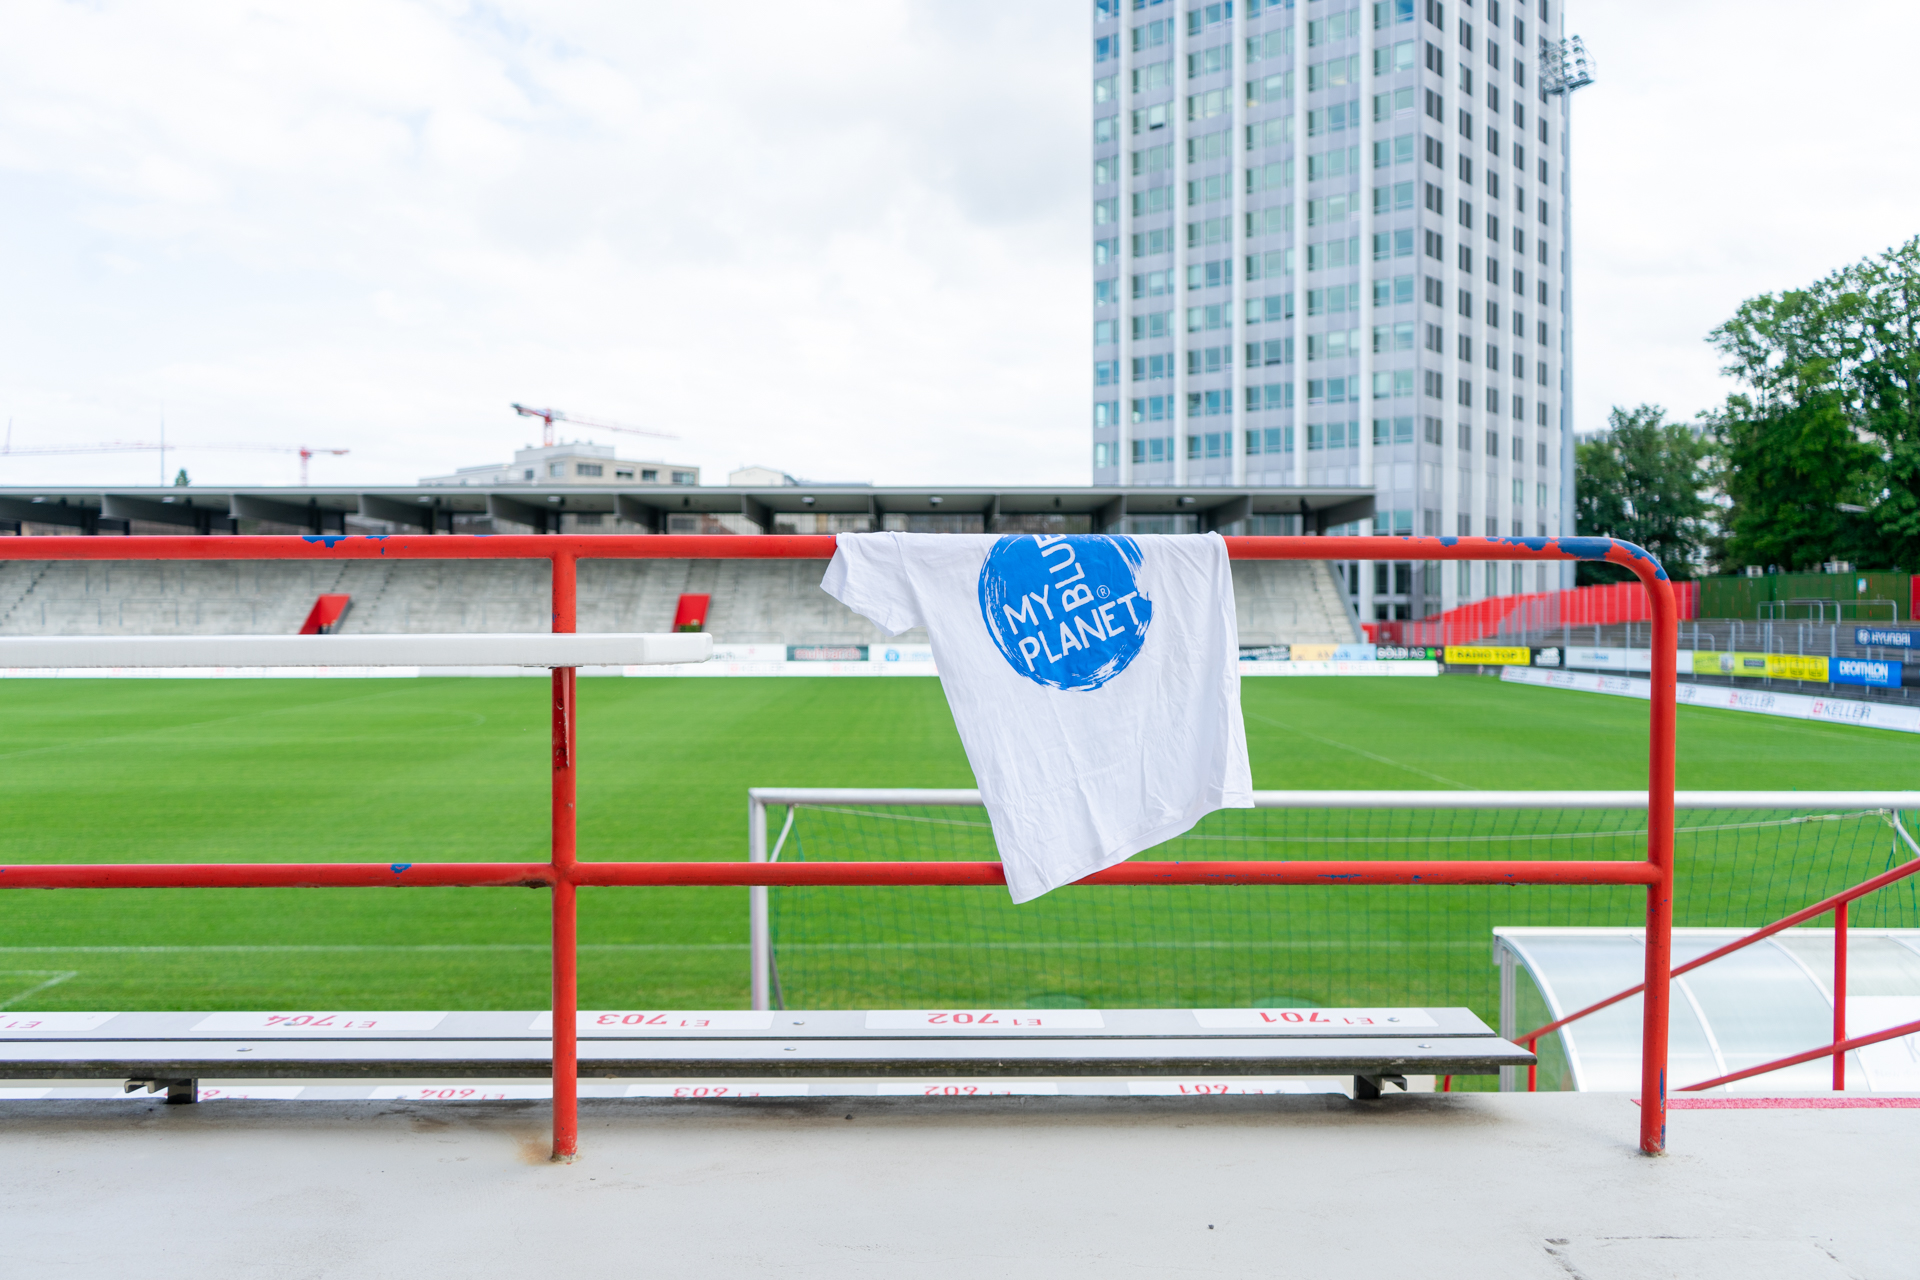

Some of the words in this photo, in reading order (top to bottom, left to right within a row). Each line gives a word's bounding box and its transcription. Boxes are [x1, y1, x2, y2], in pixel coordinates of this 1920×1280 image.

[1002, 584, 1054, 636] MY
[1018, 591, 1139, 672] PLANET
[1872, 631, 1911, 646] HYUNDAI
[1409, 647, 1426, 660] AG
[1495, 652, 1517, 660] TOP
[1839, 661, 1888, 678] DECATHLON
[1738, 692, 1776, 708] KELLER
[1824, 701, 1871, 719] KELLER
[263, 1015, 338, 1026] 704
[596, 1014, 668, 1025] 703
[927, 1013, 999, 1024] 702
[1013, 1018, 1042, 1026] E1
[1259, 1012, 1331, 1022] 701
[680, 1019, 711, 1027] E1
[420, 1088, 476, 1100] 604
[673, 1086, 728, 1097] 603
[924, 1085, 978, 1095] 602
[1179, 1084, 1229, 1095] 601
